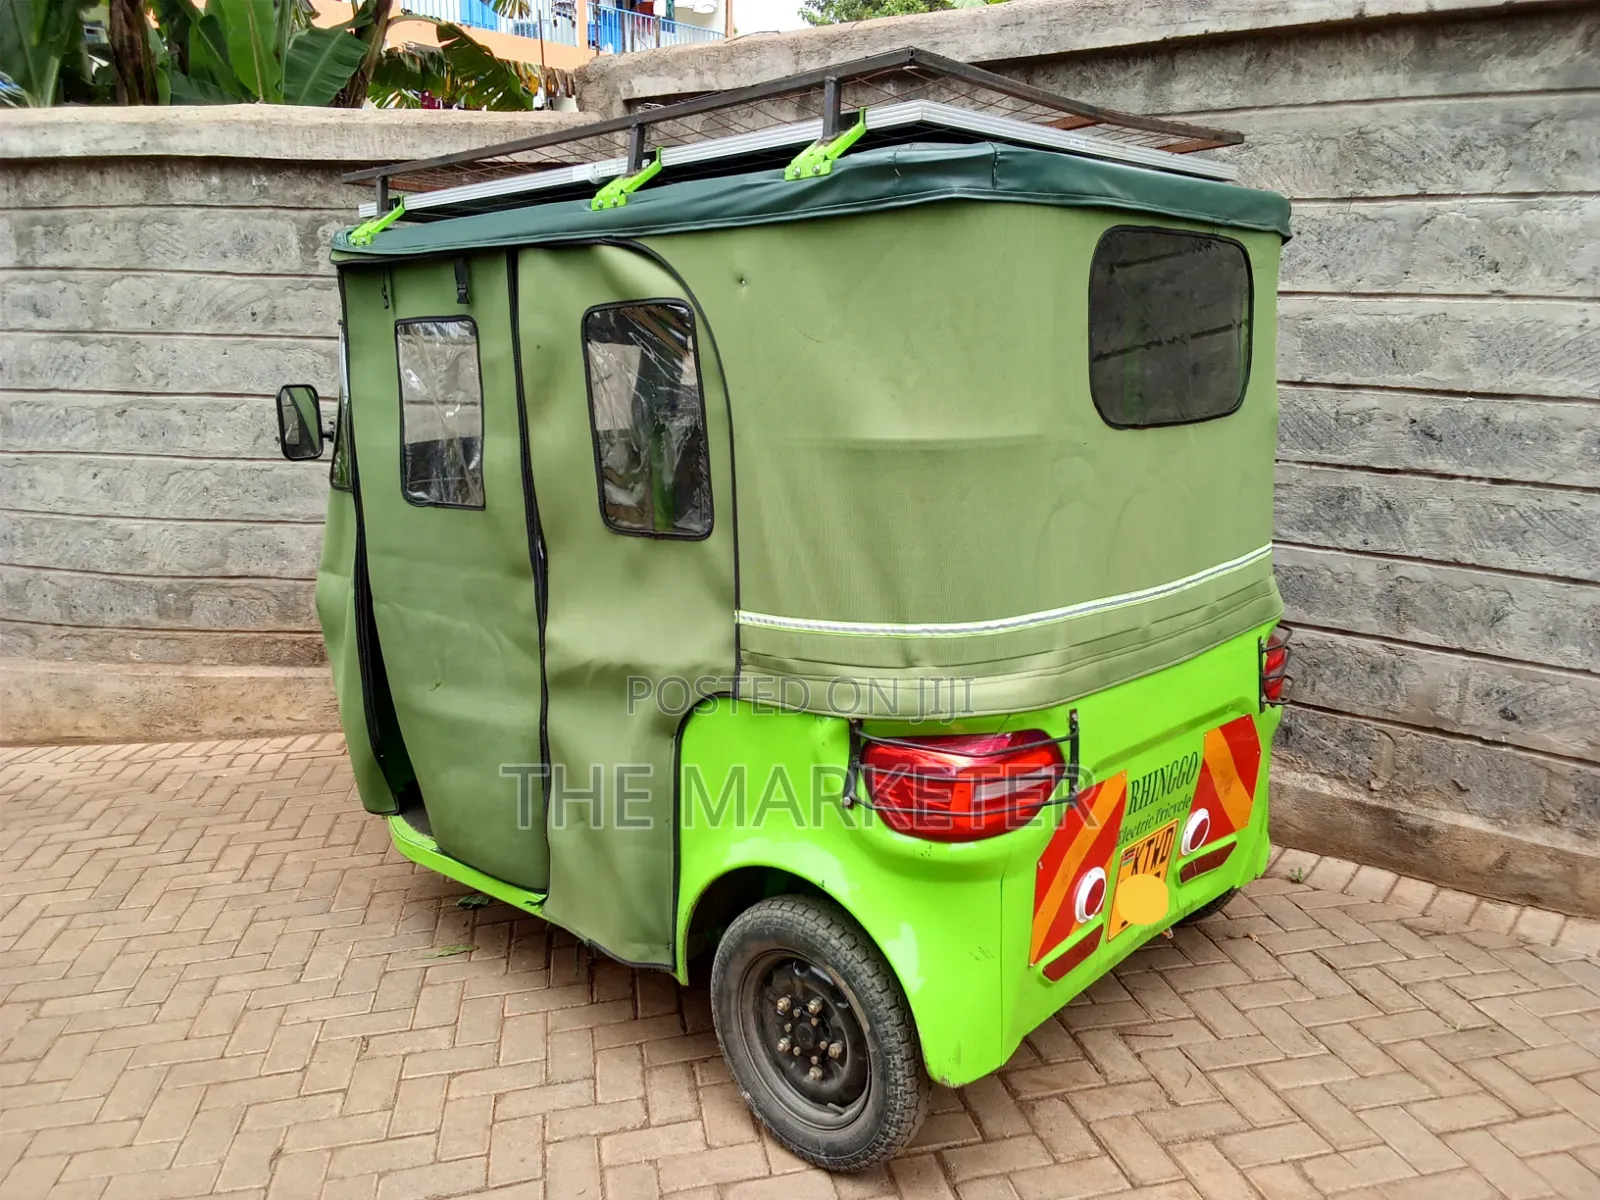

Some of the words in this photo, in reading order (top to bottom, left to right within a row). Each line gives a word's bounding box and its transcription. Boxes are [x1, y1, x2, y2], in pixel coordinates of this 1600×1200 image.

[1127, 751, 1198, 816] RHINGGO
[1117, 813, 1153, 847] Electric
[1155, 793, 1191, 825] Tricycle
